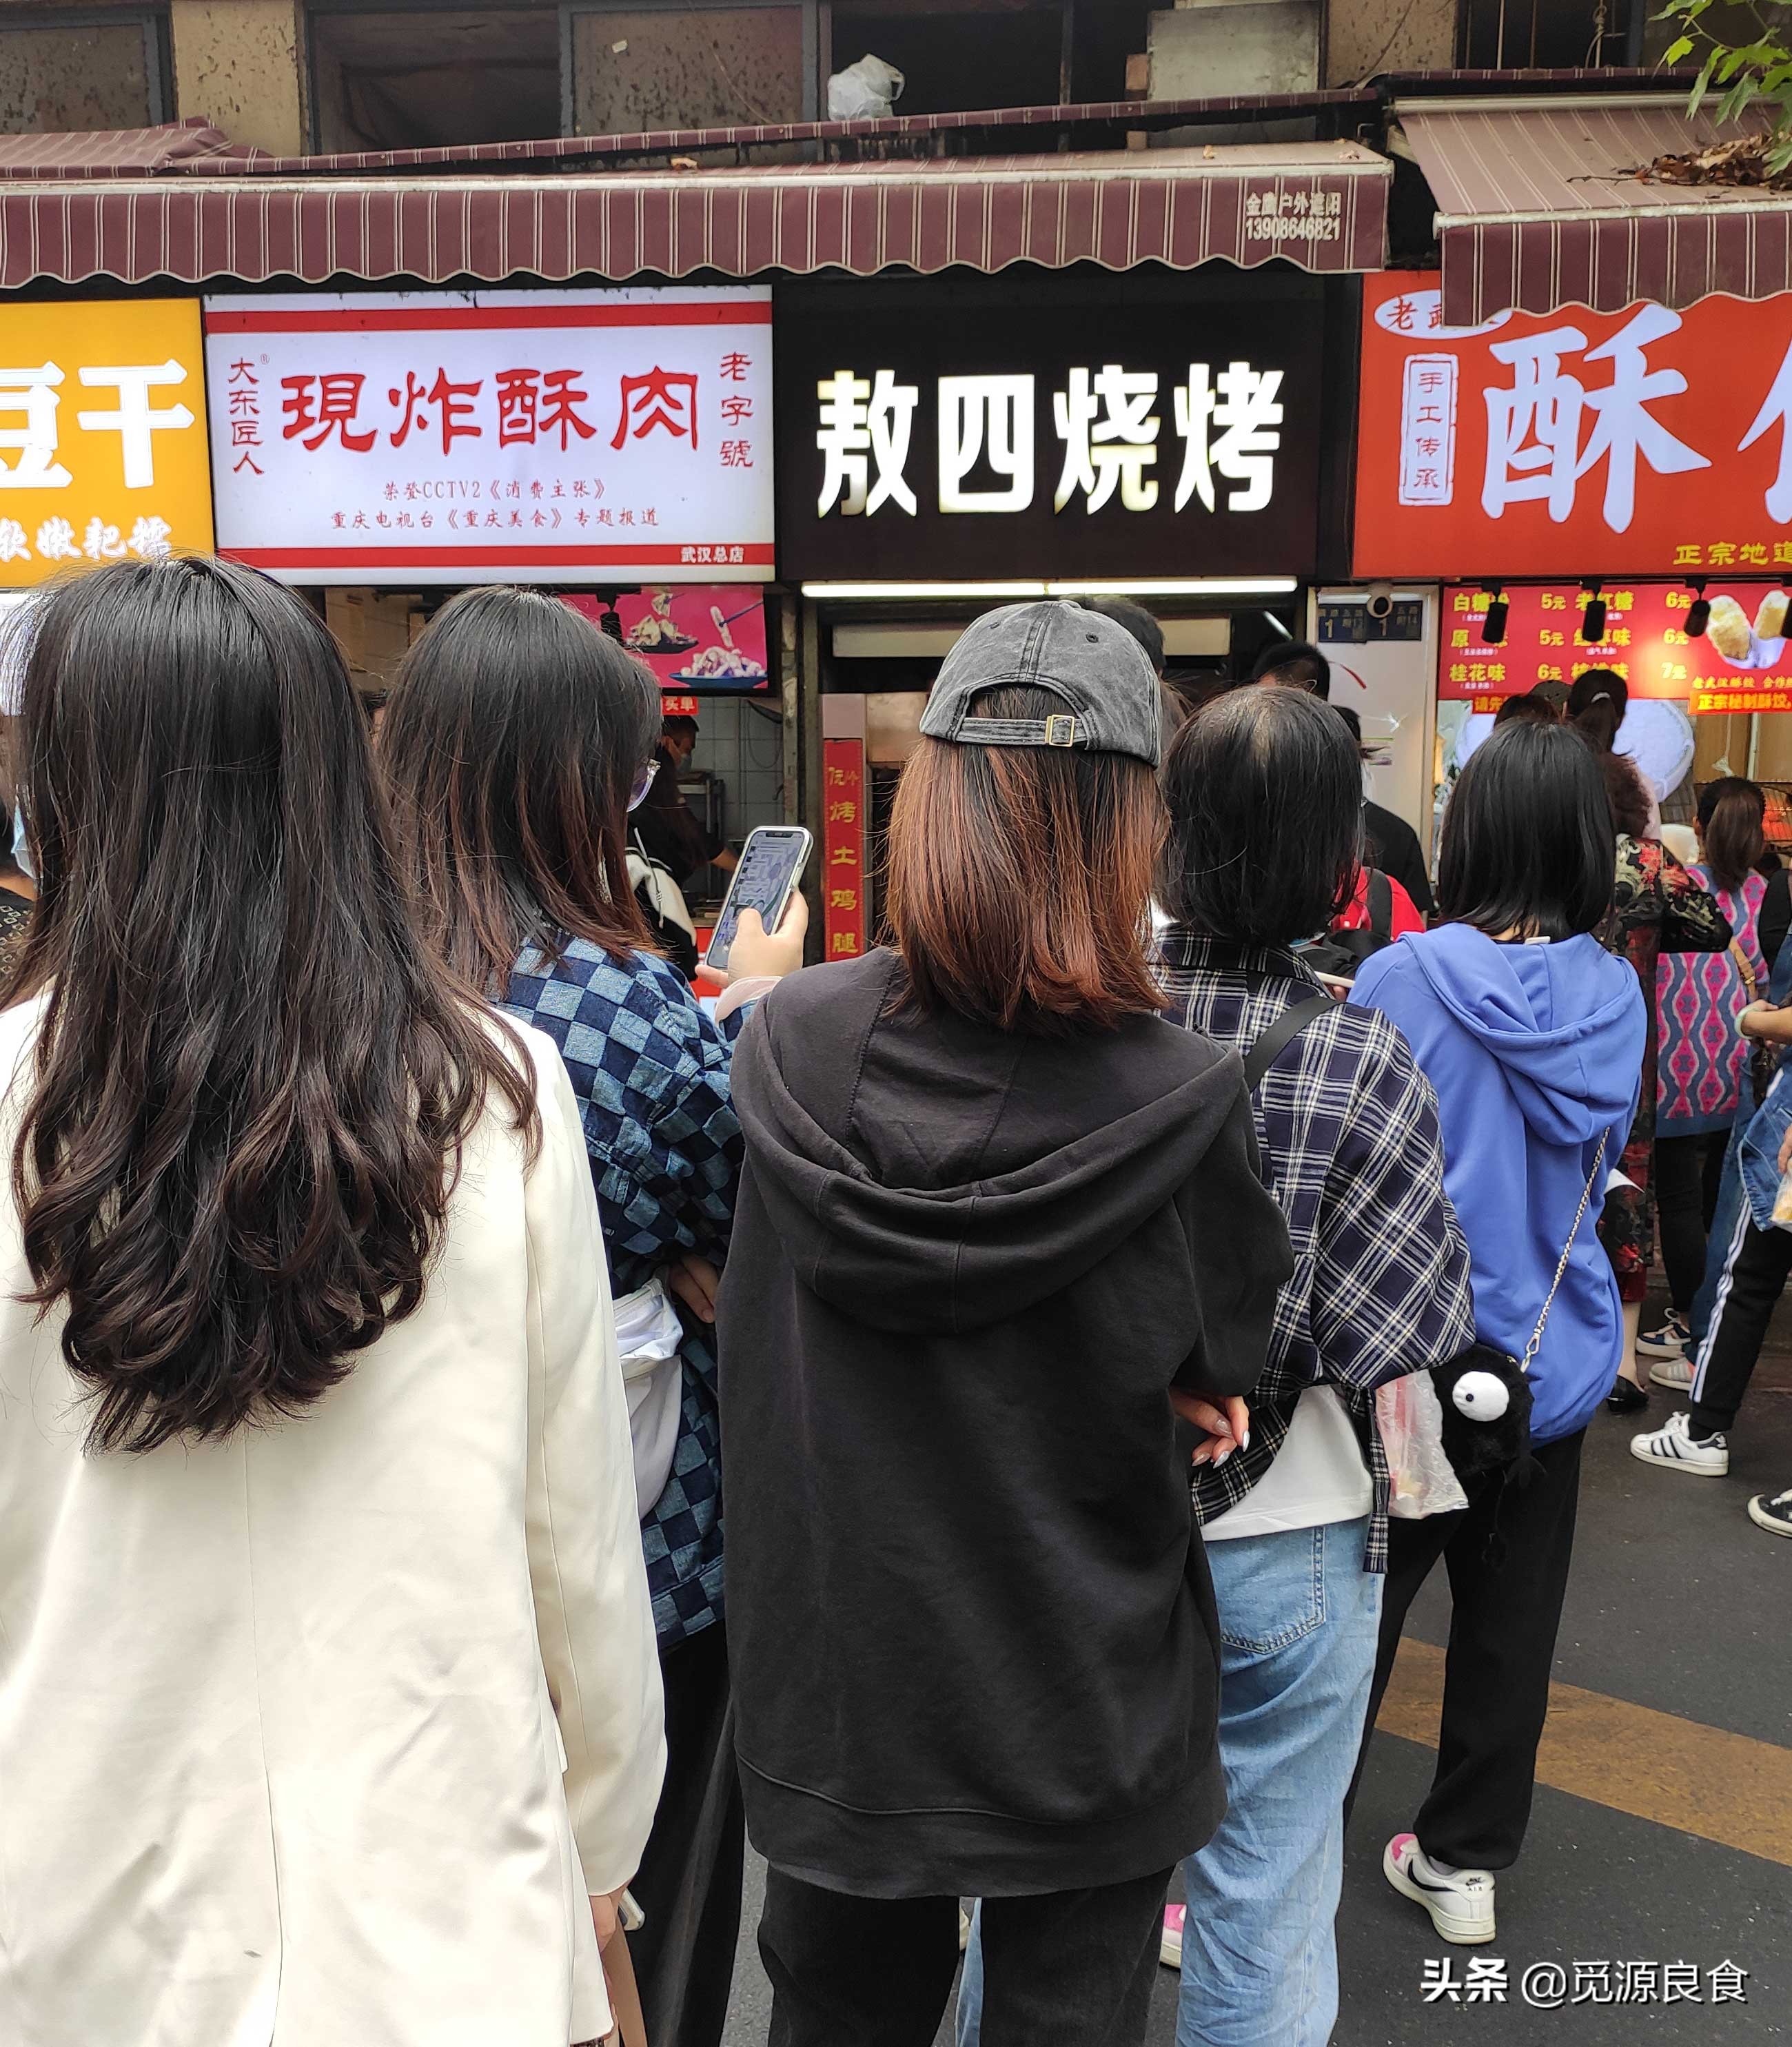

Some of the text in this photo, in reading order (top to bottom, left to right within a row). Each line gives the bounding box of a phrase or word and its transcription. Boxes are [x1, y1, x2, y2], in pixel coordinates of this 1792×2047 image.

[1245, 216, 1341, 241] 13908646821
[228, 357, 265, 475] 大东匠人
[720, 352, 754, 467] 老字號
[0, 358, 195, 488] 豆干
[1413, 372, 1445, 488] 手工传承
[817, 361, 1285, 518] 敖四烧烤
[681, 545, 744, 563] 武汉总店
[1541, 593, 1566, 610] 5元
[1666, 591, 1691, 609] 6元
[1539, 629, 1564, 646] 5元
[1663, 628, 1689, 645] 6元
[1449, 662, 1506, 682] 桂花味
[1537, 663, 1562, 680] 6元
[830, 801, 859, 954] 烤土鸡腿
